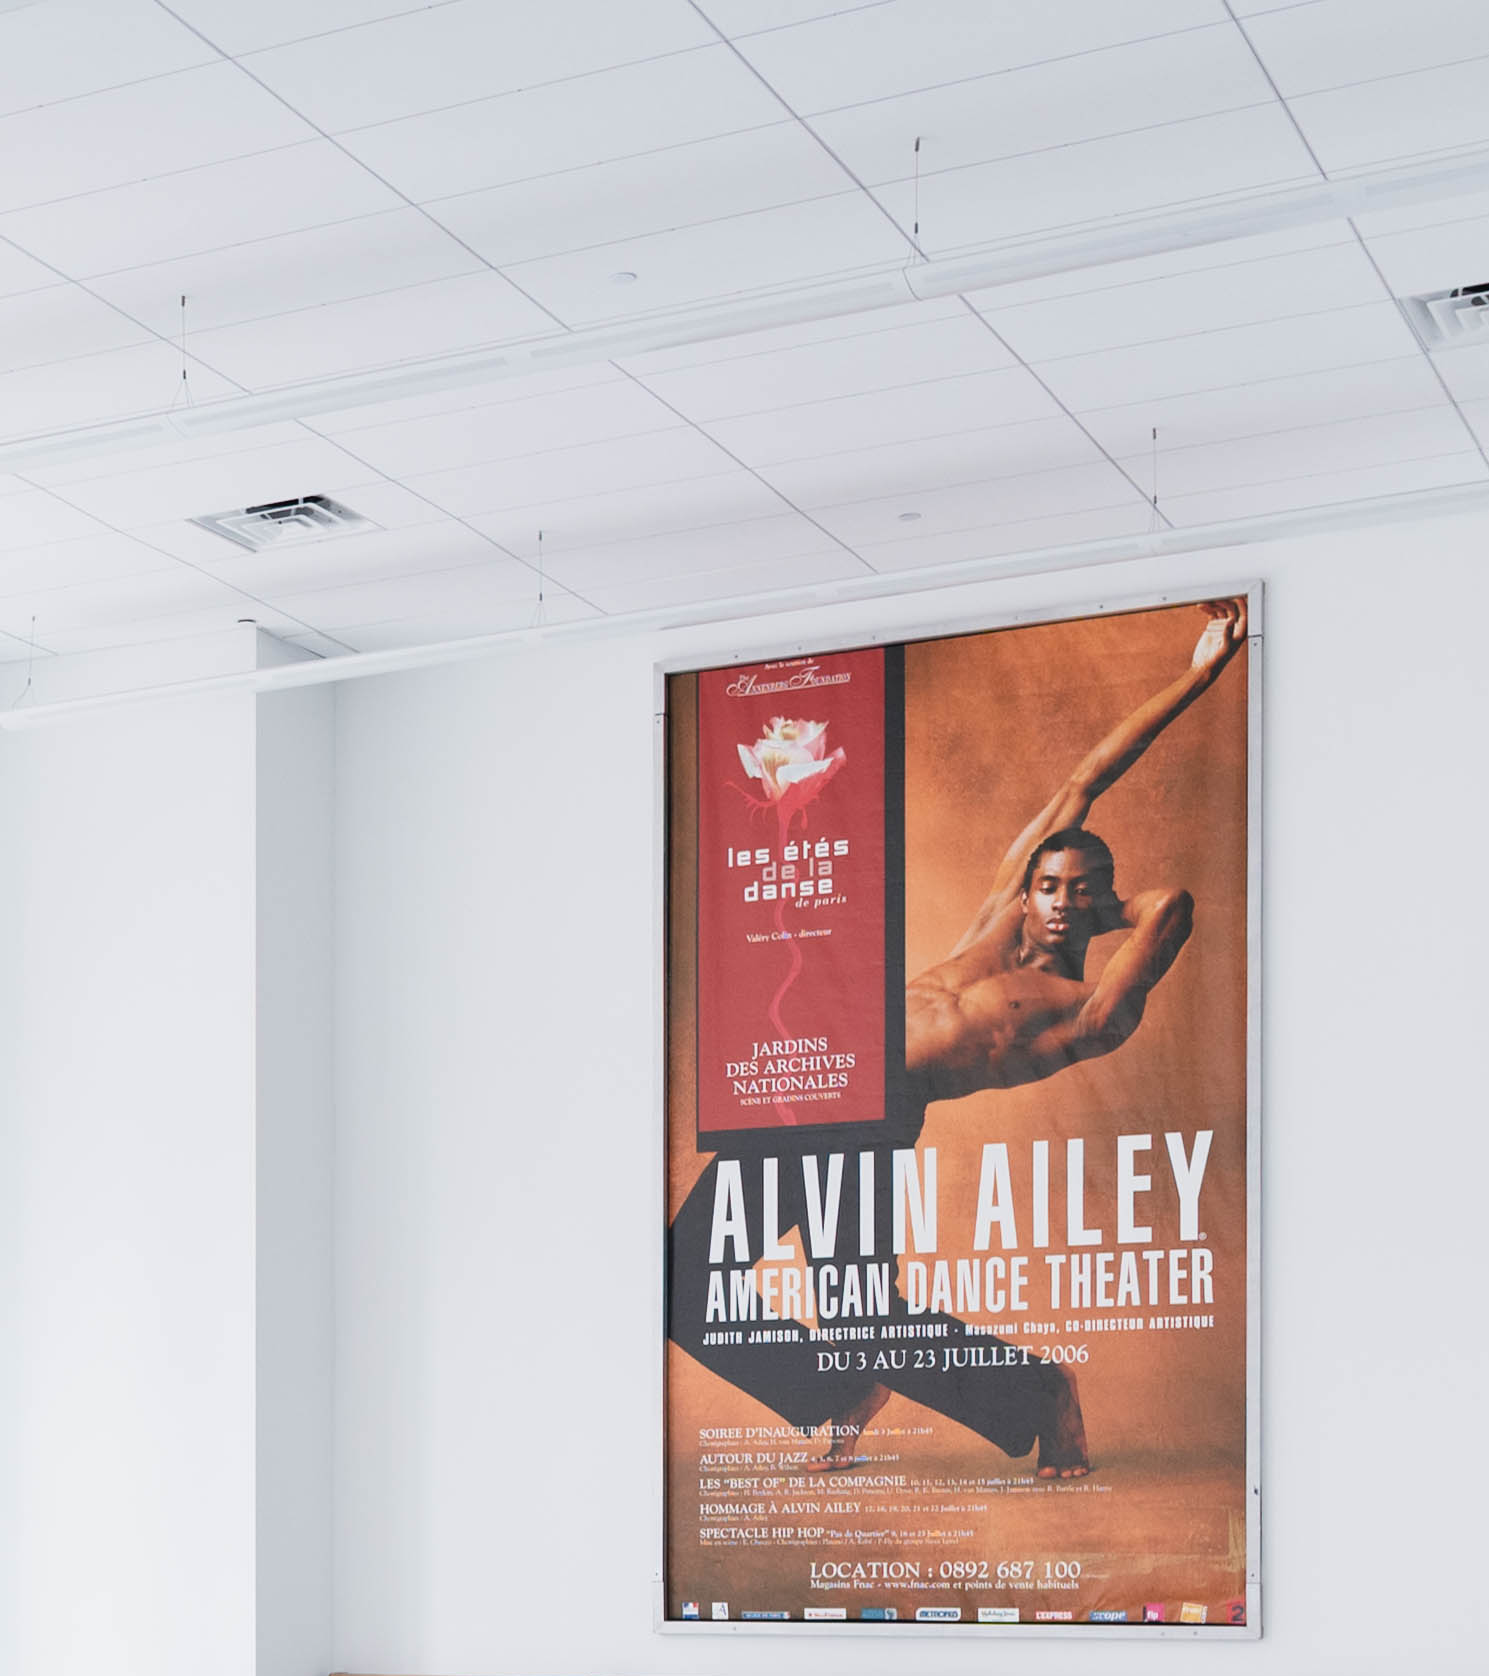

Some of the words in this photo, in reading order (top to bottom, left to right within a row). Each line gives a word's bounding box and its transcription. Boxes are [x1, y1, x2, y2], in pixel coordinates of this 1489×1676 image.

[728, 847, 770, 868] les
[784, 837, 849, 861] étés
[762, 861, 796, 882] de
[809, 857, 833, 877] la
[744, 878, 833, 903] danse
[795, 897, 809, 908] de
[752, 1037, 828, 1060] JARDINS
[726, 1061, 760, 1078] DES
[763, 1053, 856, 1075] ARCHIVES
[733, 1072, 849, 1095] NATIONALES
[708, 1147, 938, 1264] ALVIN
[973, 1130, 1214, 1251] AILEY
[705, 1262, 890, 1323] AMERICAN
[907, 1256, 1029, 1316] DANCE
[1045, 1248, 1214, 1309] THEATER
[702, 1330, 743, 1346] JUDITH
[748, 1329, 804, 1344] JAMISON,
[809, 1326, 875, 1342] DIRECTRICE
[881, 1323, 949, 1340] ARTISTIQUE
[1149, 1315, 1215, 1330] ARTISTIQUE
[817, 1351, 850, 1371] DU
[855, 1352, 868, 1371] 3
[873, 1349, 907, 1370] AU
[913, 1349, 936, 1369] 23
[942, 1345, 1033, 1372] JUILLET
[1040, 1343, 1089, 1365] 2006
[745, 1425, 860, 1439] D'INAUGURATION
[700, 1452, 753, 1465] AUTOUR
[756, 1452, 776, 1464] DU
[779, 1451, 808, 1465] JAZZ
[699, 1478, 721, 1489] LES
[789, 1477, 807, 1488] DE
[809, 1476, 826, 1487] LA
[829, 1475, 906, 1488] COMPAGNIE
[700, 1503, 765, 1514] HOMMAGE
[768, 1500, 778, 1513] À
[781, 1502, 820, 1514] ALVIN
[825, 1502, 862, 1513] AILEY
[699, 1527, 769, 1539] SPECTACLE
[772, 1527, 794, 1538] HIP
[797, 1527, 825, 1538] HOP
[810, 1562, 921, 1579] LOCATION
[939, 1561, 990, 1579] 0892
[996, 1561, 1035, 1579] 687
[1044, 1561, 1081, 1579] 100
[810, 1579, 851, 1590] Magasins
[853, 1579, 875, 1589] Fnac
[884, 1579, 950, 1590] www.fnac.com
[952, 1580, 963, 1589] et
[964, 1580, 992, 1592] points
[994, 1579, 1007, 1589] de
[1009, 1580, 1034, 1589] vente
[1036, 1579, 1080, 1590] habituels
[1232, 1604, 1244, 1621] 2
